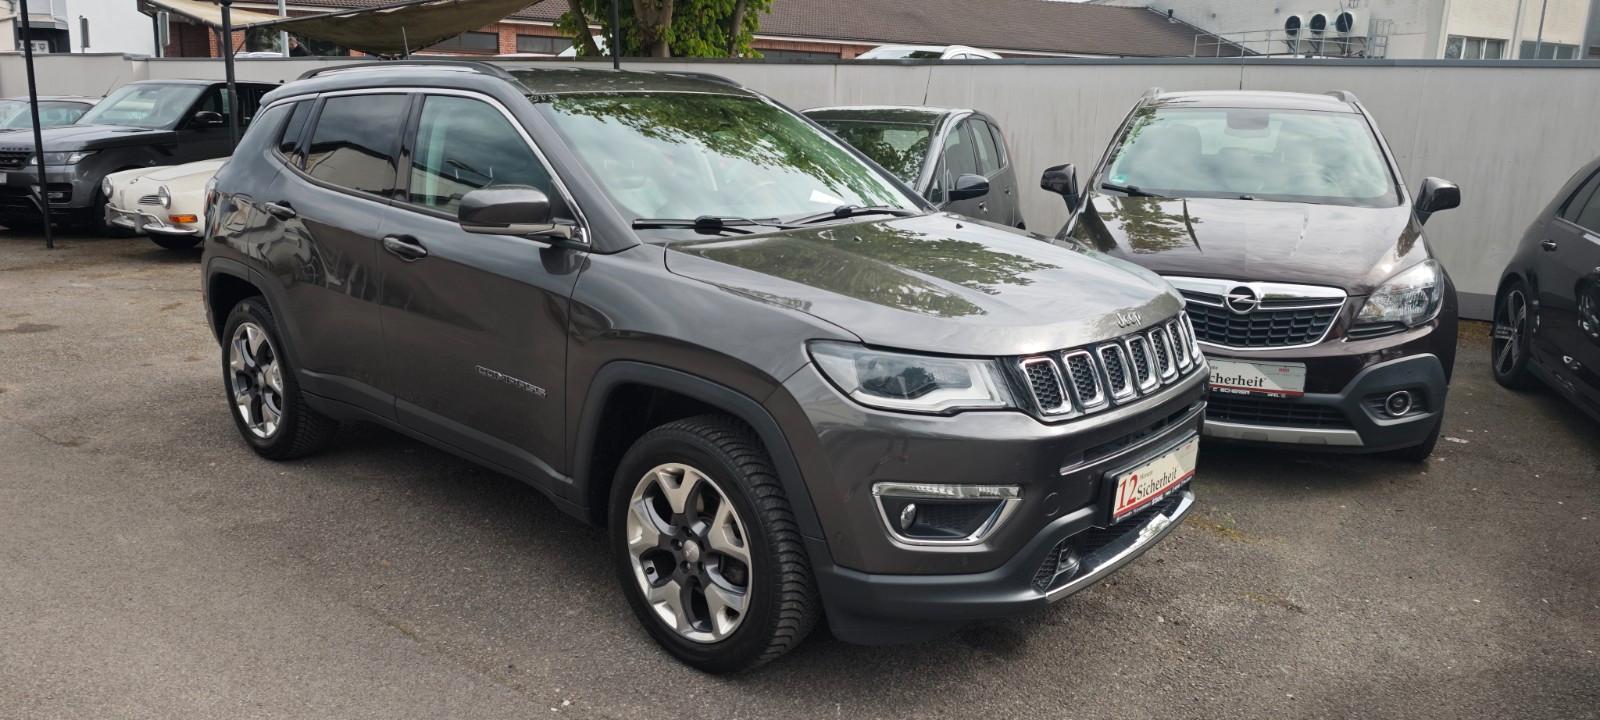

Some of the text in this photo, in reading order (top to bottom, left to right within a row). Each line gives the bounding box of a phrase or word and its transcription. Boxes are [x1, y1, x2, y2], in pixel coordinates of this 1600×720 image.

[1116, 311, 1141, 328] Jeep
[476, 365, 546, 398] COMPASS
[1210, 373, 1264, 387] cherheit
[1117, 474, 1138, 511] 12
[1137, 467, 1177, 500] Sicherheit
